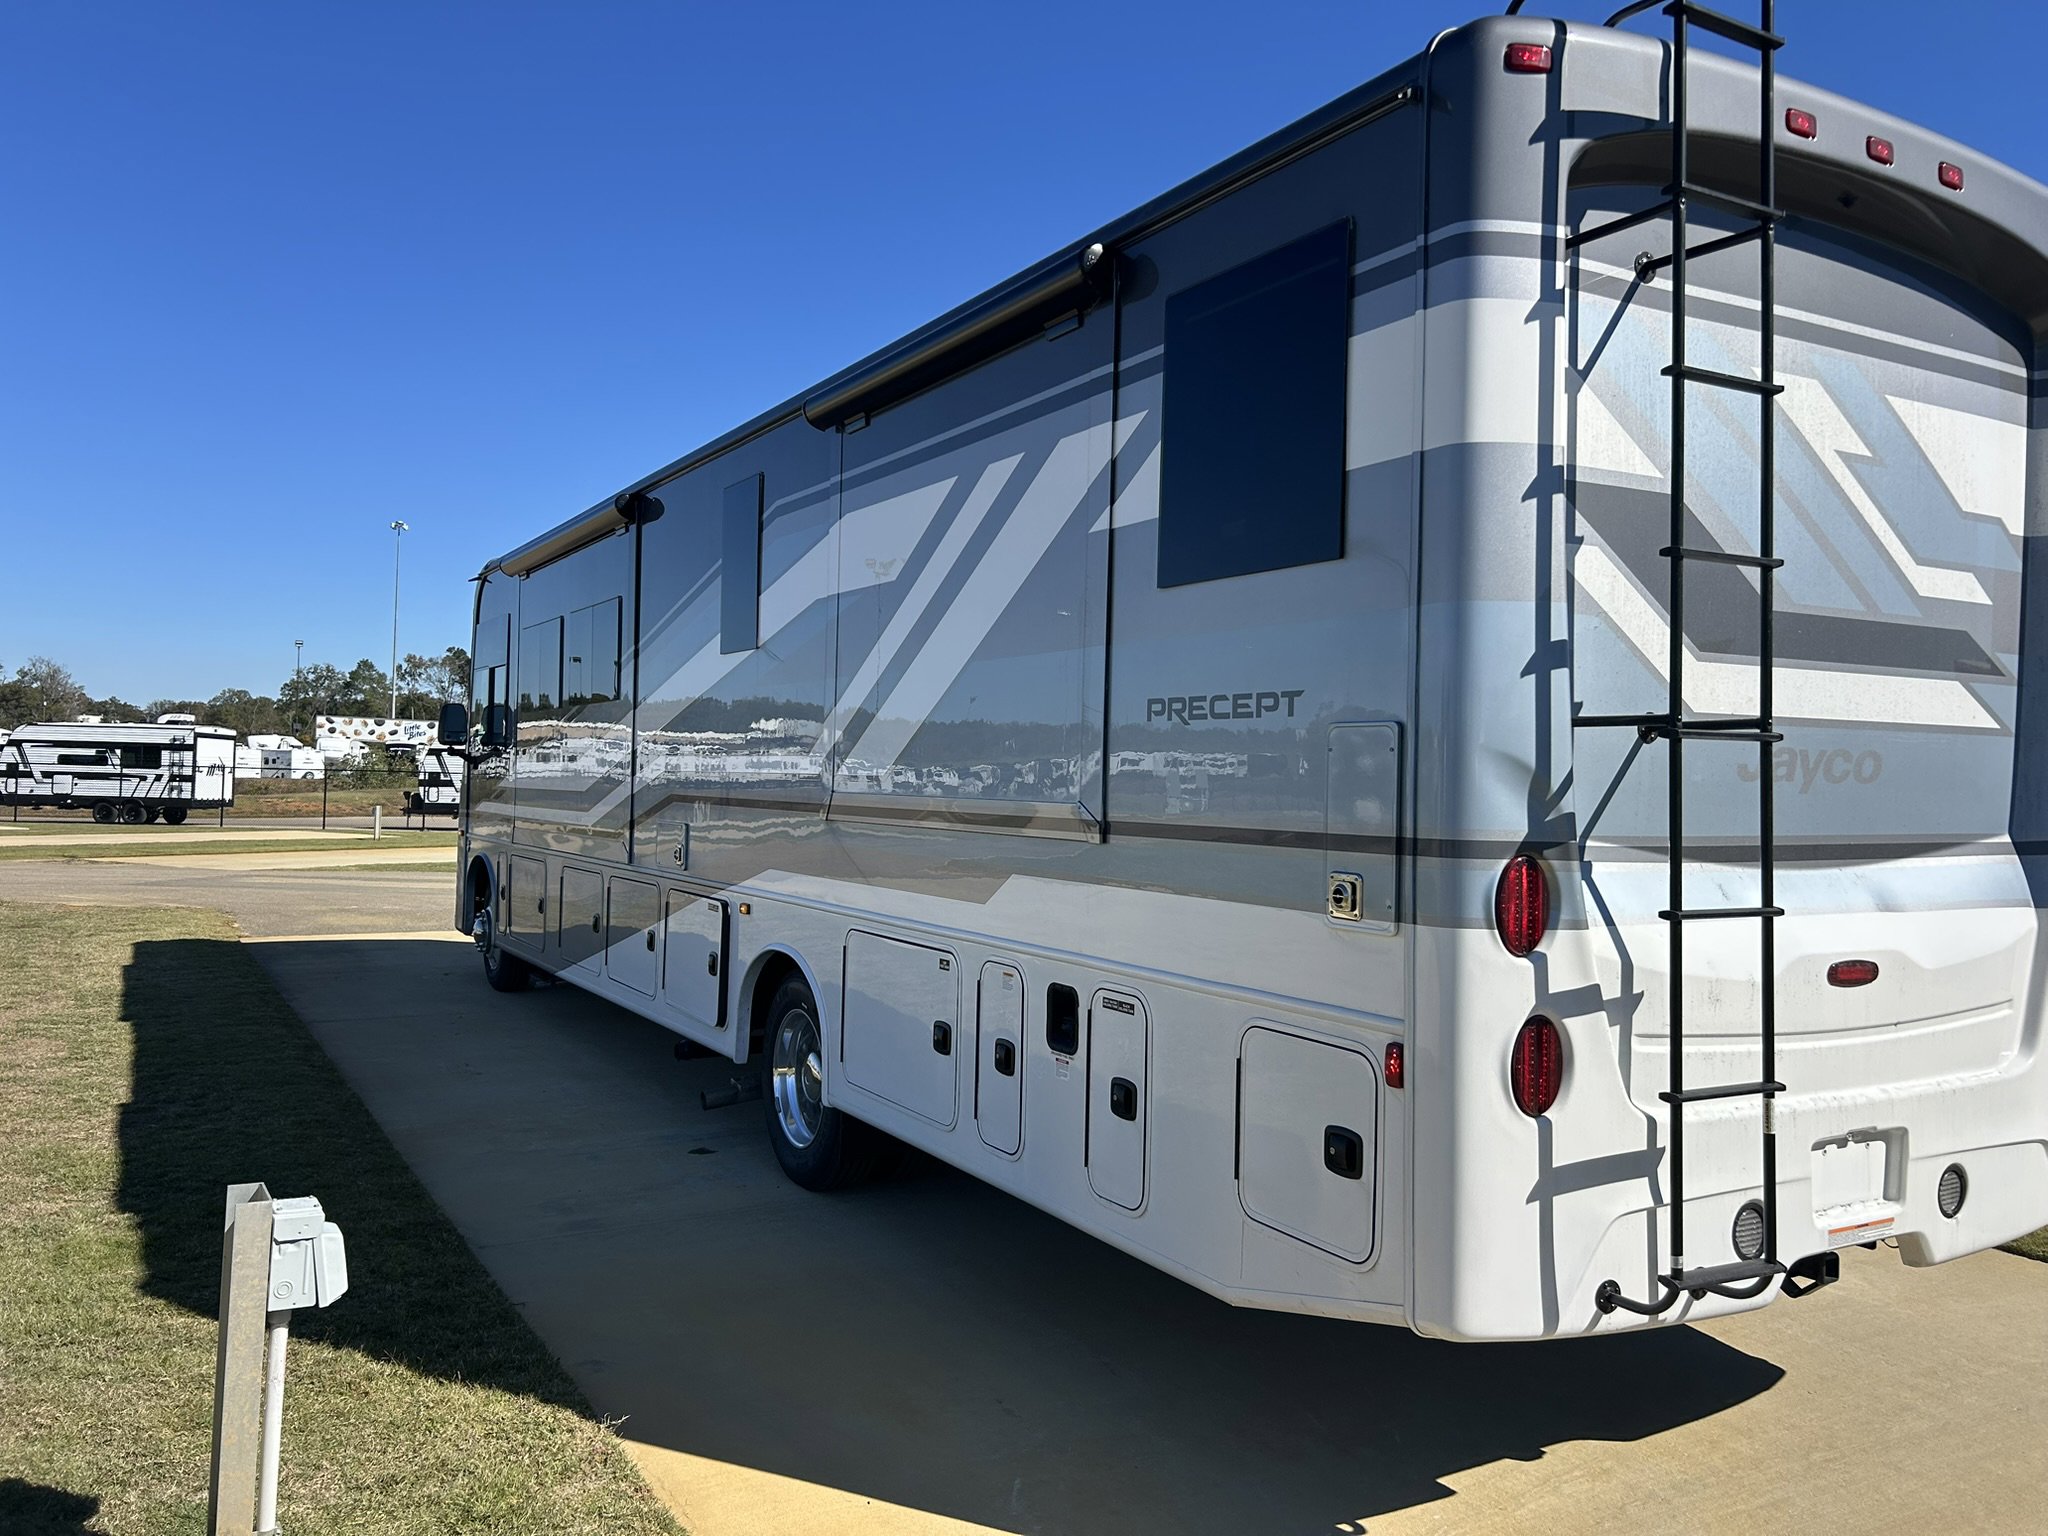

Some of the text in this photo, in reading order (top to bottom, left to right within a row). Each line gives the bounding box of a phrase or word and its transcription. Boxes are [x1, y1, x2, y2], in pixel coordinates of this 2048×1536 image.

[1147, 690, 1305, 726] PRECEPT
[404, 724, 421, 735] Little
[408, 731, 427, 741] Bites
